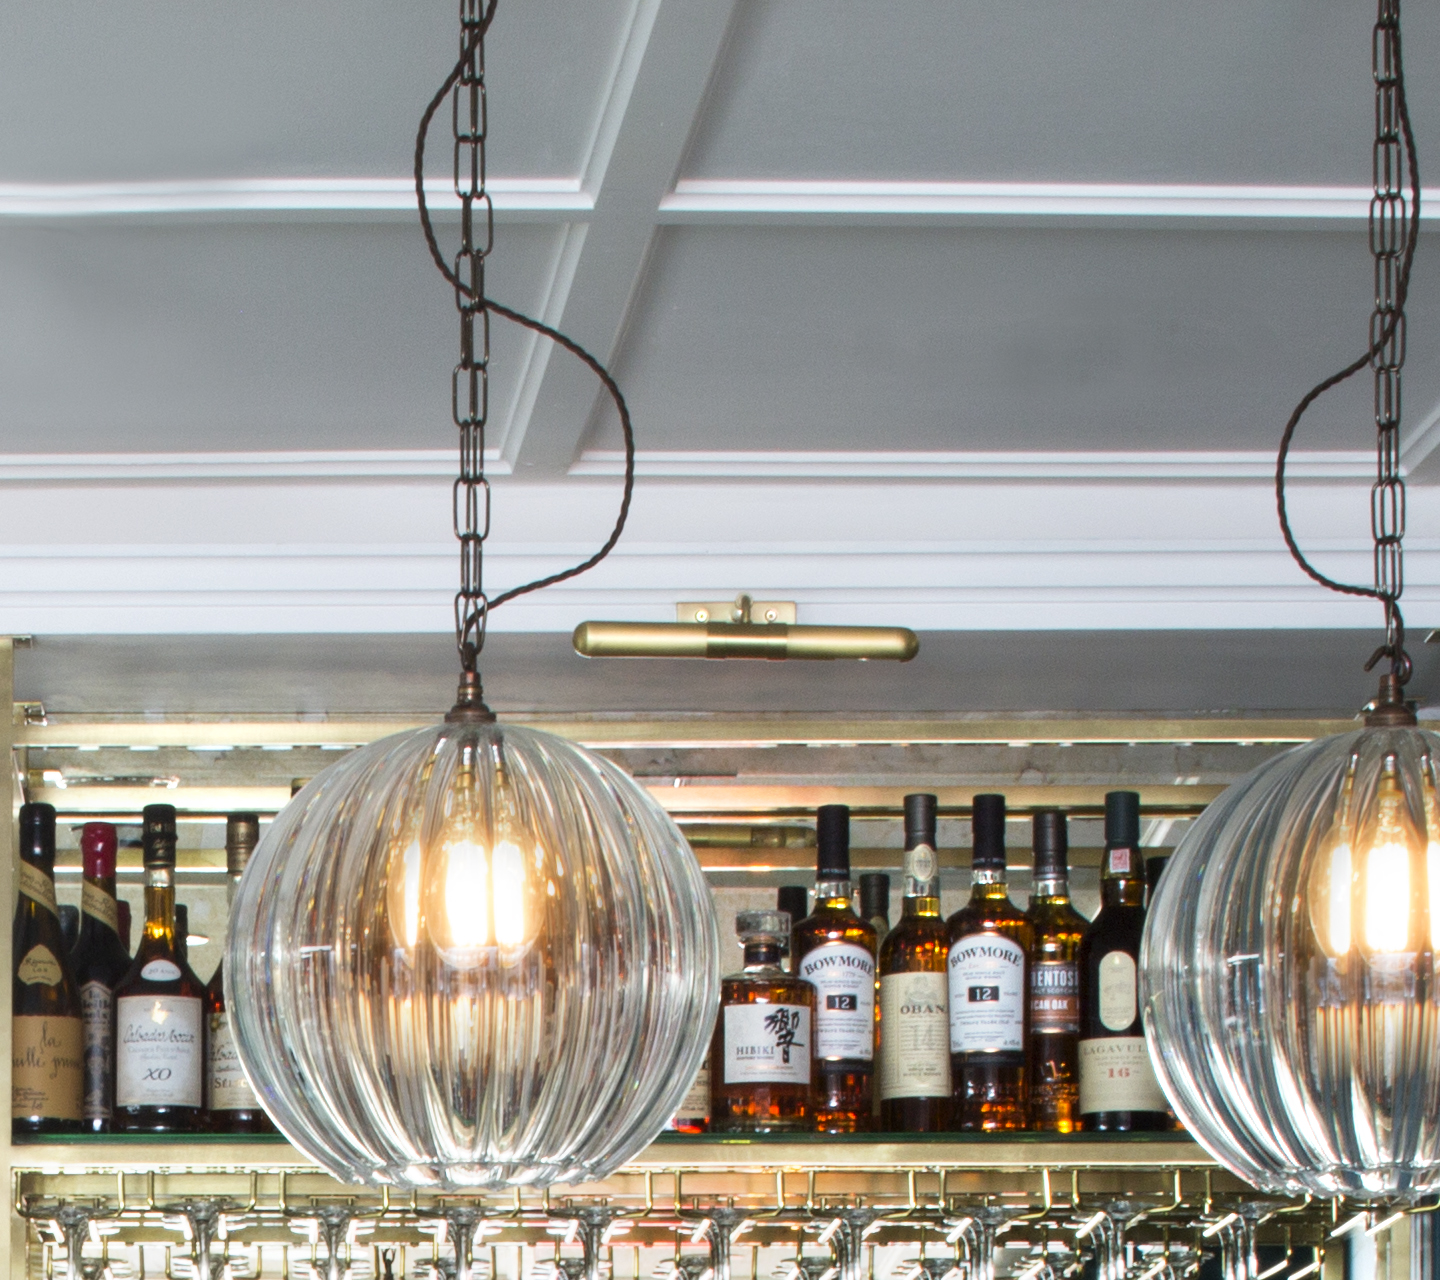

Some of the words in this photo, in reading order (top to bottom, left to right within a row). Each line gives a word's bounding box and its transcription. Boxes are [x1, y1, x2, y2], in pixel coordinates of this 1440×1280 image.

[949, 946, 1021, 968] BOWMORE
[803, 954, 875, 977] BOWMORE
[975, 987, 993, 1001] 12
[834, 996, 851, 1010] 12
[900, 1004, 946, 1015] OBAN
[736, 1045, 776, 1056] HIBIKI
[1083, 1043, 1143, 1056] LAGAVUL
[142, 1067, 172, 1081] XO
[1107, 1067, 1131, 1079] 16
